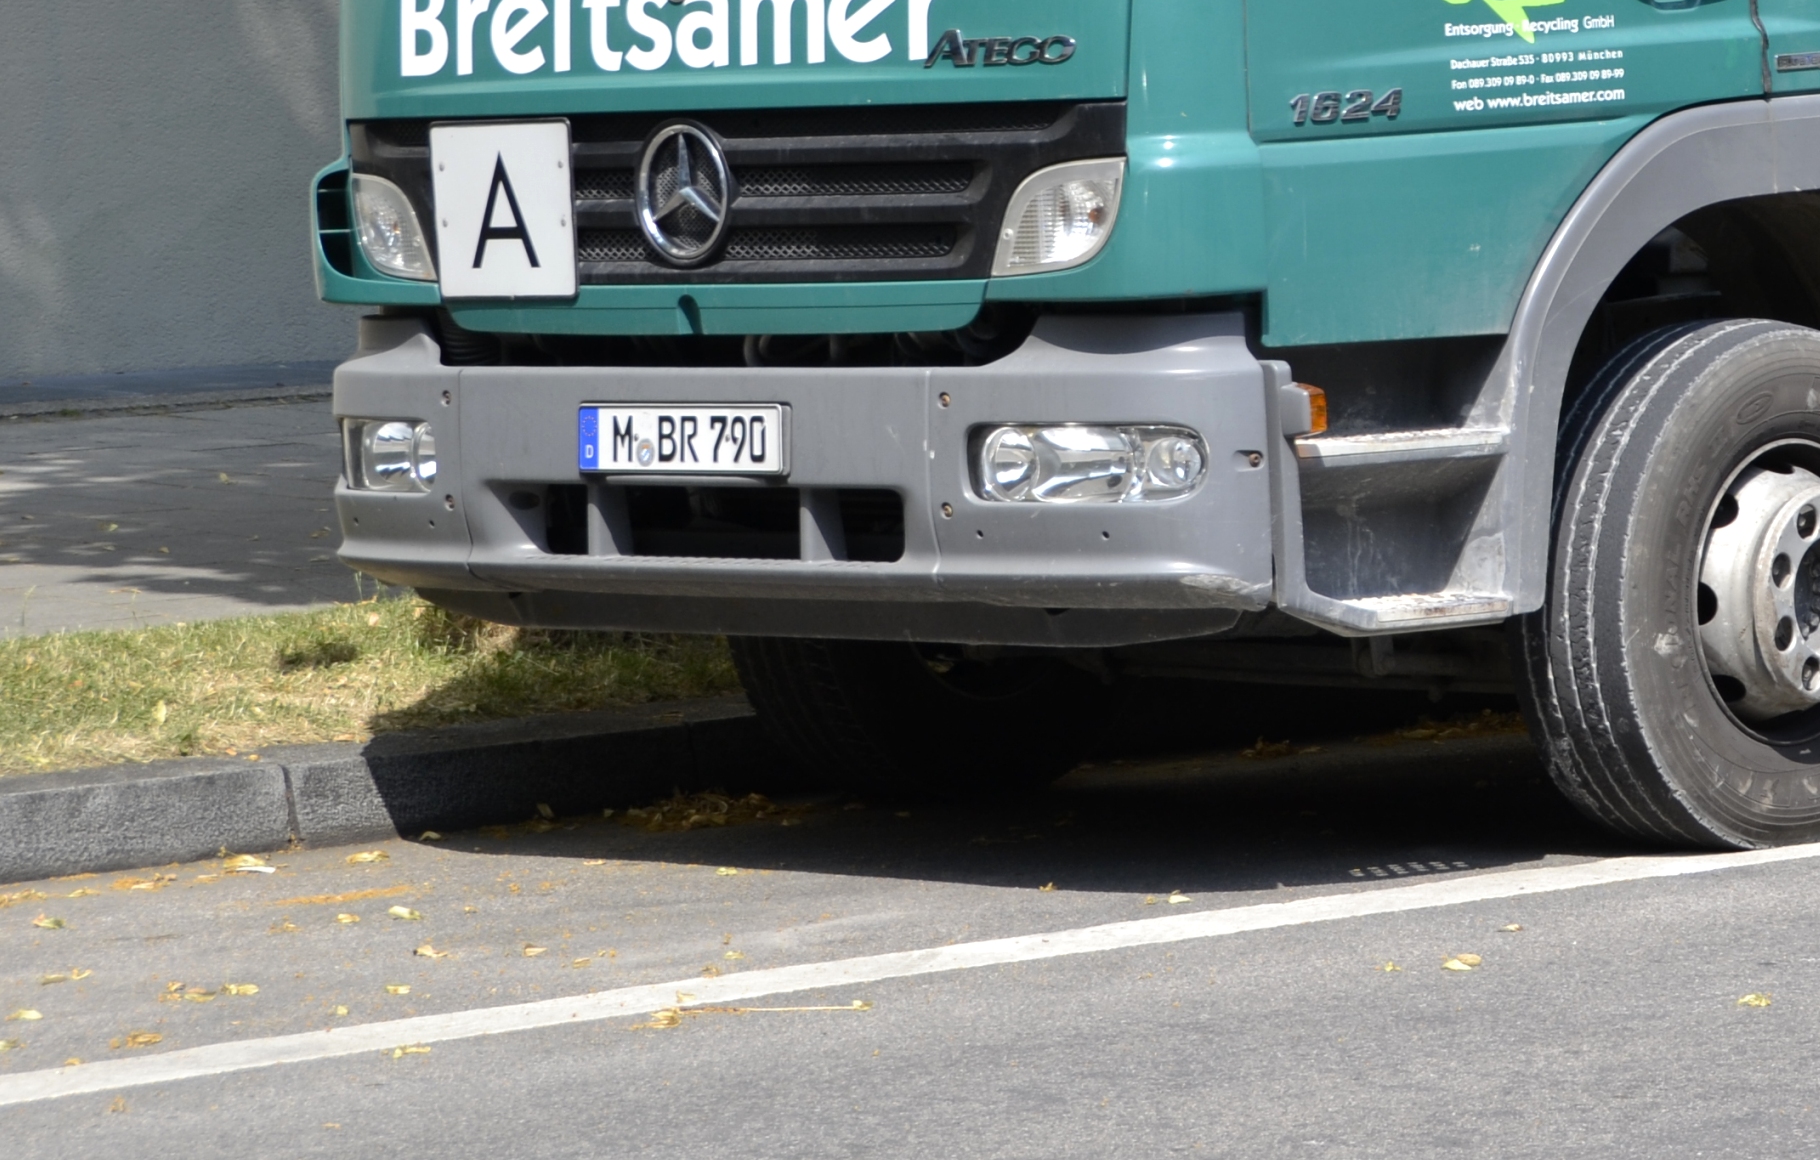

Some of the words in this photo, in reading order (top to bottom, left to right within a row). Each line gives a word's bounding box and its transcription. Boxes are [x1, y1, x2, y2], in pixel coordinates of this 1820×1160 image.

[1444, 23, 1513, 38] Entsorgung
[1522, 16, 1579, 34] Recycling
[1583, 15, 1615, 30] GmbH
[1541, 51, 1574, 64] 80993
[1577, 48, 1623, 61] München
[1451, 79, 1468, 90] Fon
[1540, 73, 1555, 84] Fax
[1289, 87, 1403, 125] 1624
[1453, 96, 1484, 111] web
[1487, 88, 1625, 109] www.breitsamer.com
[472, 150, 541, 269] A
[613, 415, 633, 463] M
[658, 415, 699, 463] BR
[710, 415, 766, 463] 790
